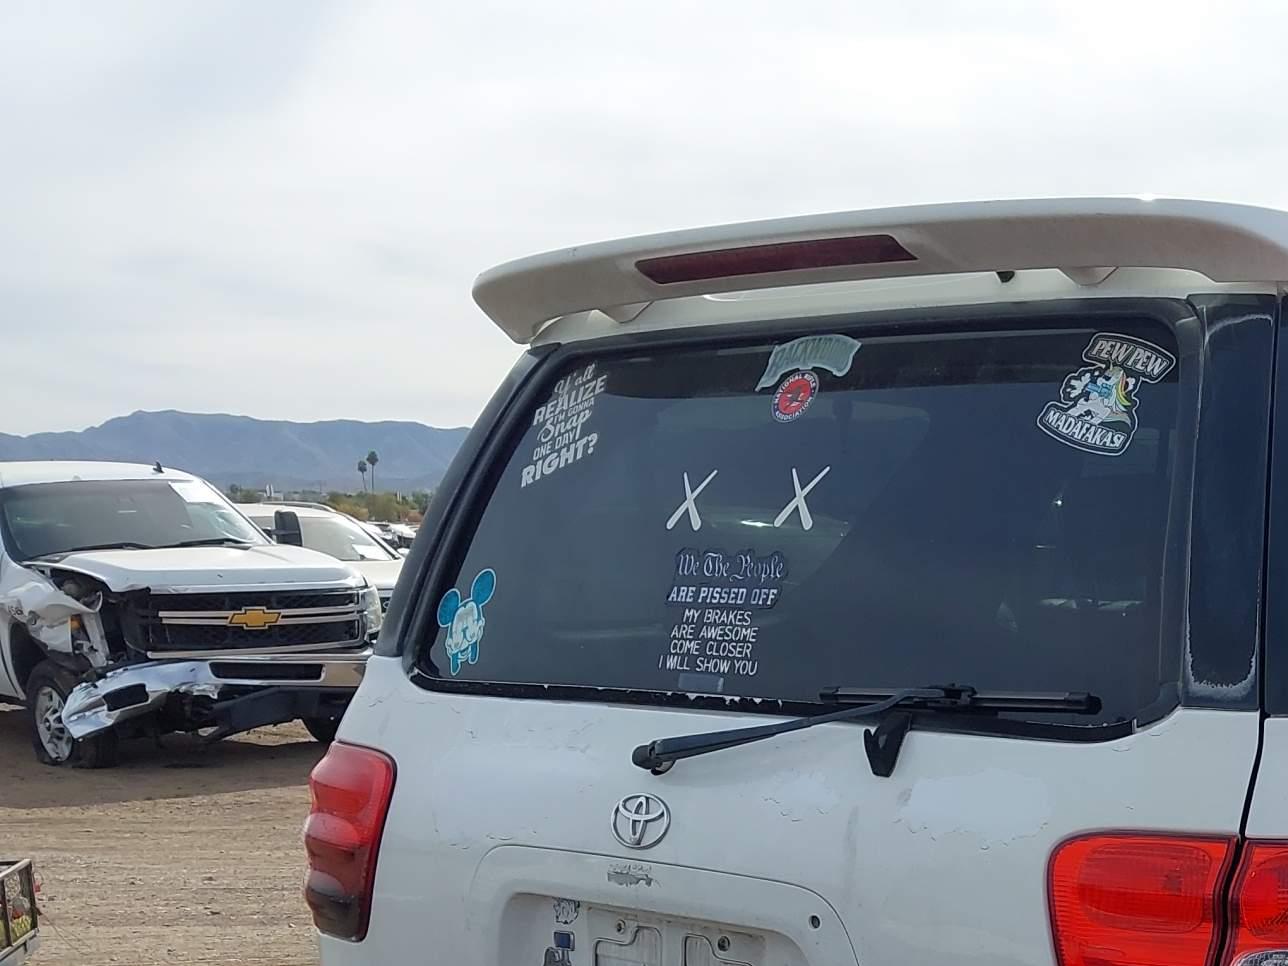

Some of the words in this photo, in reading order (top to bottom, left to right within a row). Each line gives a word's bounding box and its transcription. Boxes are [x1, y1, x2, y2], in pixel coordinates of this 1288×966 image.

[1091, 339, 1130, 363] PEW
[1127, 346, 1168, 377] PEW
[532, 375, 607, 426] REALIZE
[774, 373, 802, 404] NATIONAL
[567, 397, 595, 417] GONNA
[537, 409, 593, 443] Snap
[533, 441, 553, 461] ONE
[555, 428, 577, 449] DAY
[521, 432, 598, 488] RIGHT?
[678, 554, 699, 576] We
[703, 552, 730, 577] The
[729, 554, 784, 582] People
[668, 586, 697, 602] ARE
[698, 587, 747, 604] PISSED
[751, 589, 778, 605] OFF
[683, 608, 700, 623] MY
[704, 609, 752, 626] BRAKES
[671, 624, 696, 639] ARE
[699, 626, 758, 642] AWESOME
[670, 640, 701, 655] COME
[706, 641, 752, 658] CLOSER
[666, 655, 691, 671] WILL
[695, 657, 731, 674] SHOW
[733, 660, 758, 676] YOU
